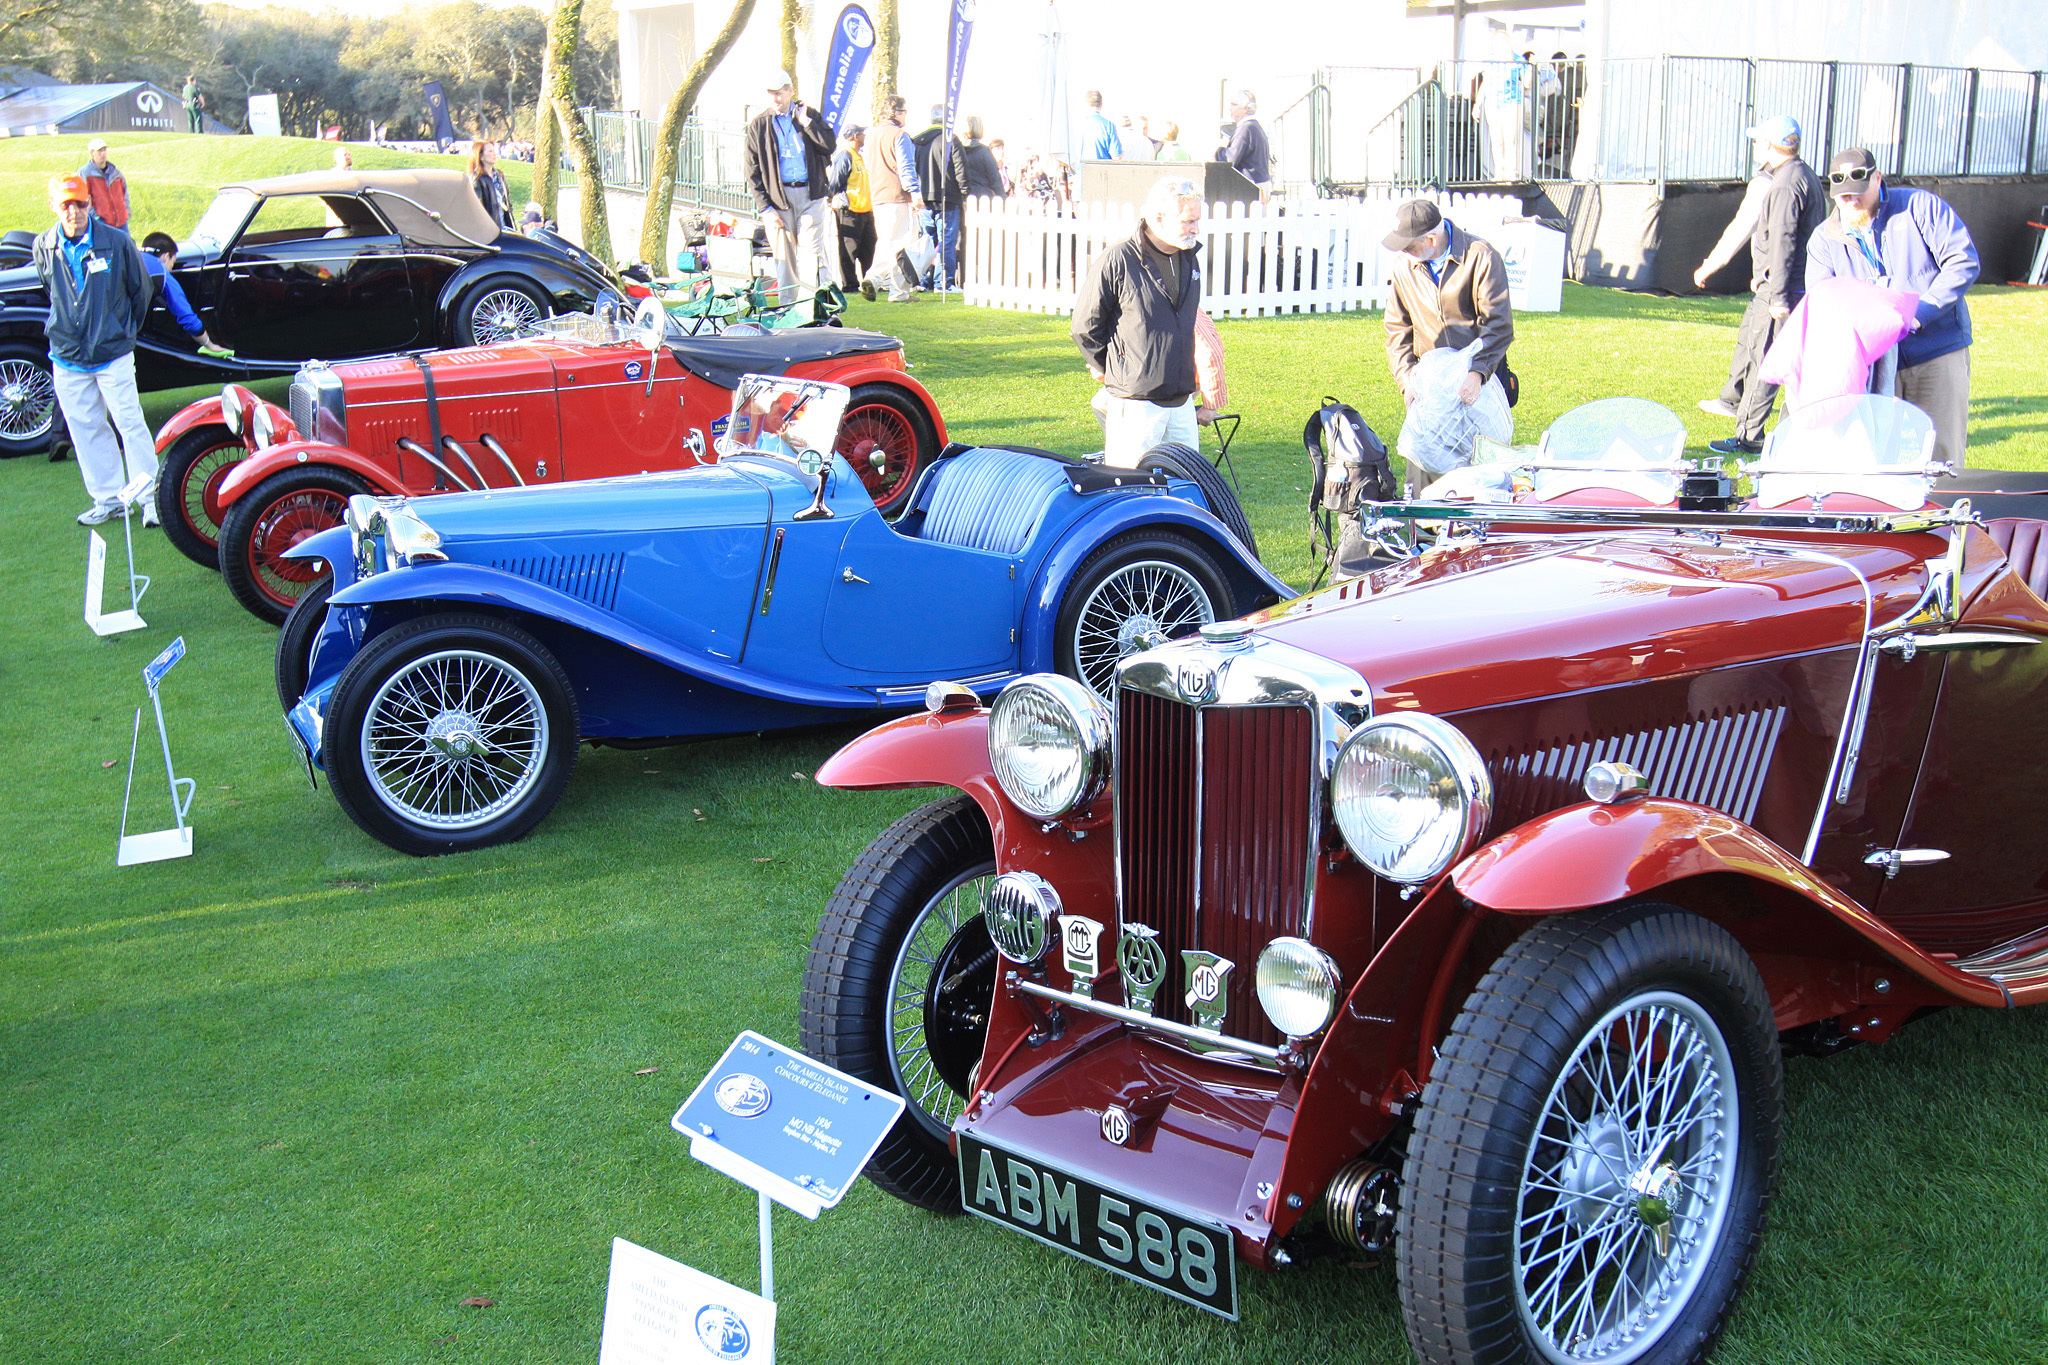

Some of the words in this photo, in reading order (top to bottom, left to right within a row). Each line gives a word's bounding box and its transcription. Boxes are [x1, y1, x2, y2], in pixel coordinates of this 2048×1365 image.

[830, 45, 855, 109] Amelia
[131, 116, 174, 128] INFINITI
[1181, 669, 1204, 693] MG
[1191, 953, 1207, 963] CAR
[1194, 969, 1217, 998] MG
[1202, 1003, 1223, 1014] CLUB
[741, 1041, 761, 1055] 2014
[774, 1065, 812, 1087] CONCOURS
[786, 1059, 801, 1073] THE
[799, 1066, 825, 1085] AMELIA
[823, 1077, 849, 1094] ISLAND
[814, 1115, 833, 1130] 1936
[1103, 1111, 1129, 1143] MG
[801, 1122, 815, 1135] NB
[812, 1128, 843, 1148] Magnette
[975, 1148, 1081, 1246] ABM
[1097, 1194, 1218, 1297] 588
